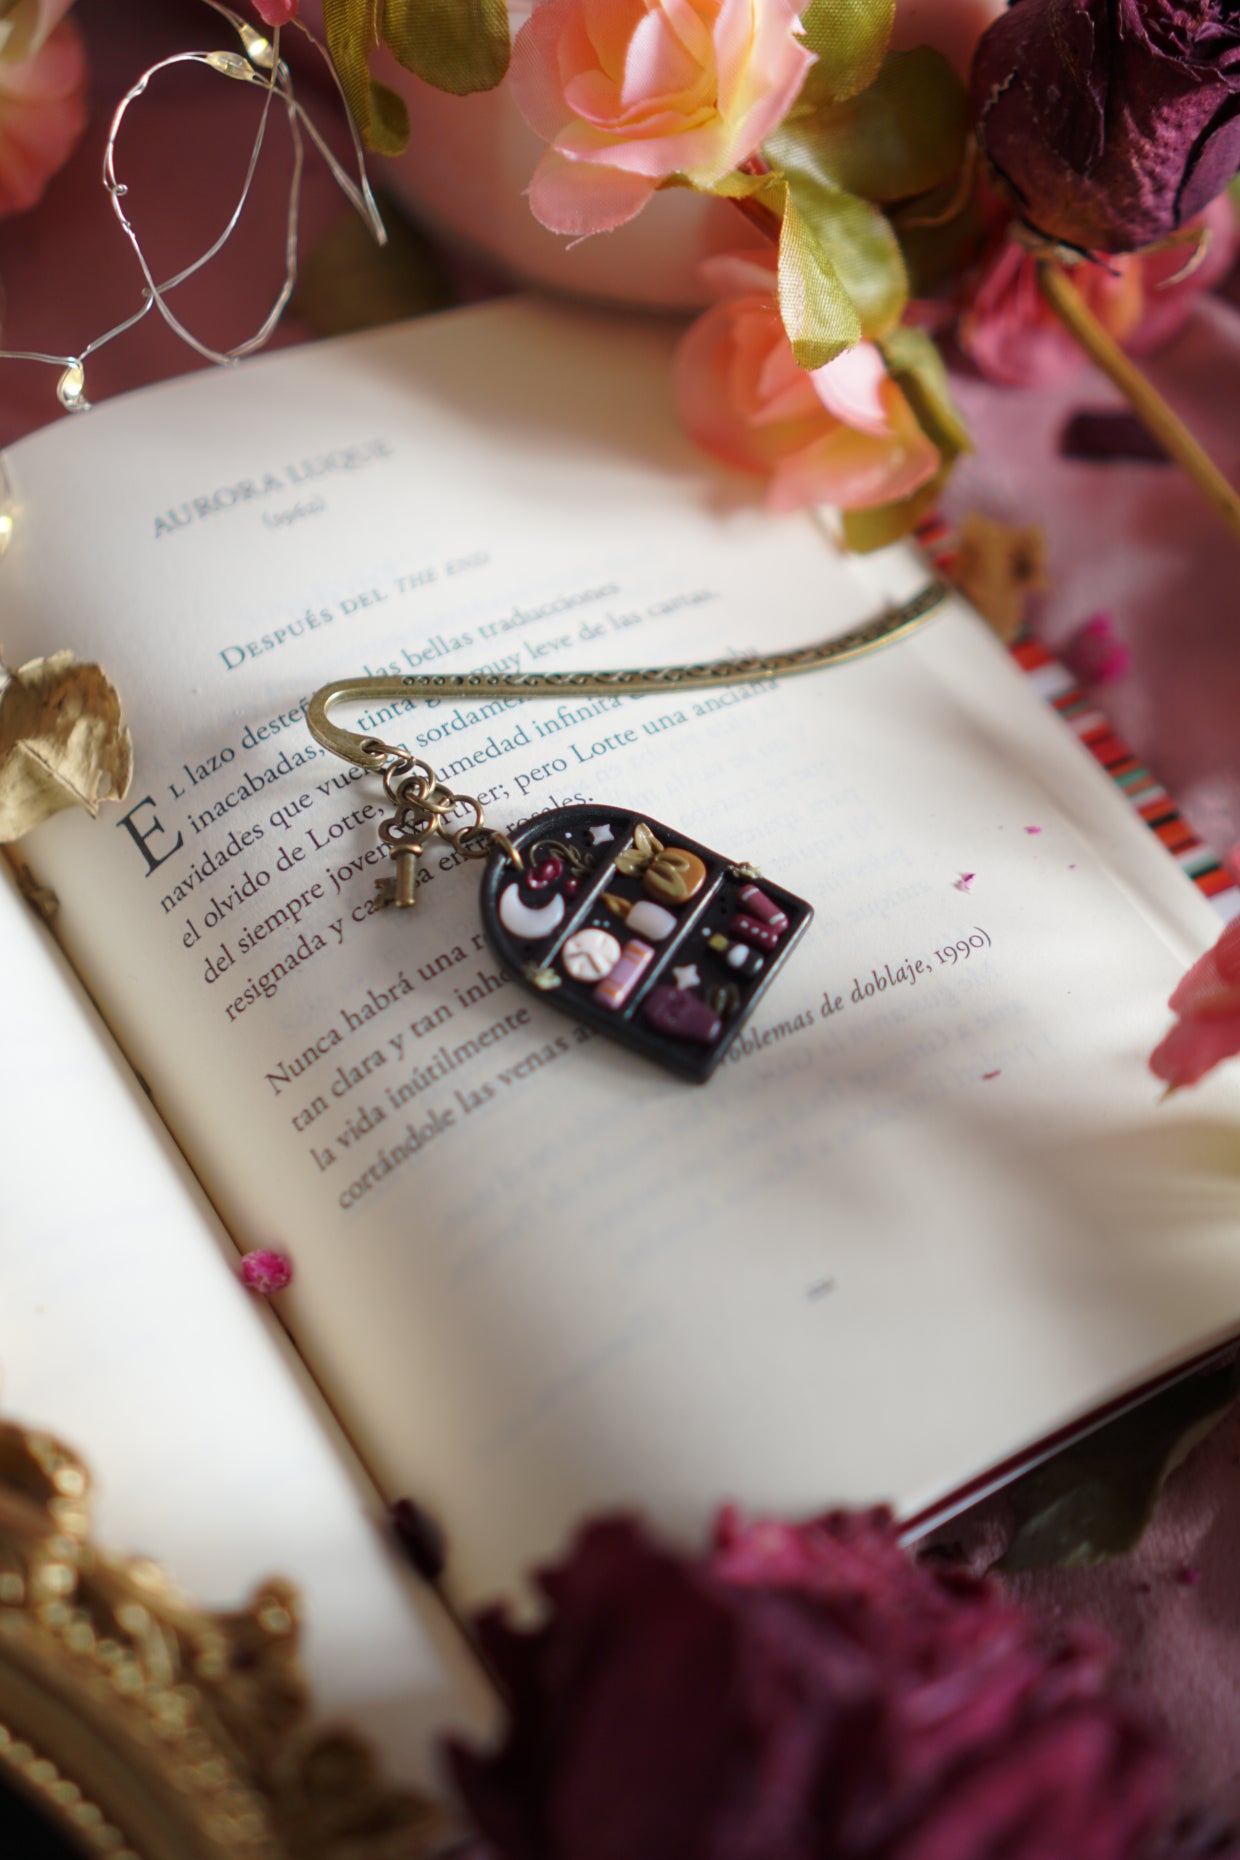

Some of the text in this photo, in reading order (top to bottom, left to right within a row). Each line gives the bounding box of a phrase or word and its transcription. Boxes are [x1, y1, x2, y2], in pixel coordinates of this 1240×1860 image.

[154, 438, 395, 539] AURORA LUQUE
[394, 566, 439, 595] THE
[445, 549, 491, 577] END
[184, 747, 236, 787] lazo
[400, 632, 475, 669] bellas
[476, 581, 622, 641] traducciones
[187, 744, 326, 834] inacabadas,
[357, 699, 417, 731] tinta
[523, 633, 574, 660] leve
[578, 620, 606, 642] de
[605, 611, 643, 631] las
[160, 821, 264, 914] navidades
[268, 791, 314, 831] que
[182, 920, 202, 949] el
[204, 867, 271, 928] olvido
[276, 842, 306, 872] de
[305, 803, 385, 850] Lotte,
[532, 695, 624, 738] infinita
[204, 950, 236, 984] del
[237, 882, 325, 955] siempre
[324, 843, 392, 895] joven
[514, 758, 567, 795] pero
[569, 729, 638, 763] Lotte
[642, 710, 688, 735] una
[692, 678, 779, 716] anciana
[224, 930, 327, 1022] resignada
[328, 915, 353, 944] y
[264, 948, 467, 1096] Nunca habrá una
[820, 992, 844, 1018] de
[851, 959, 932, 1004] doblaje,
[934, 926, 992, 966] 1990)
[291, 1095, 329, 1132] tan
[330, 1046, 387, 1099] clara
[394, 1032, 407, 1061] y
[410, 1004, 453, 1039] tan
[309, 1005, 533, 1172] la vida inútilmente
[337, 1104, 458, 1211] cortándole
[454, 1078, 497, 1114] las
[496, 1034, 571, 1088] venas
